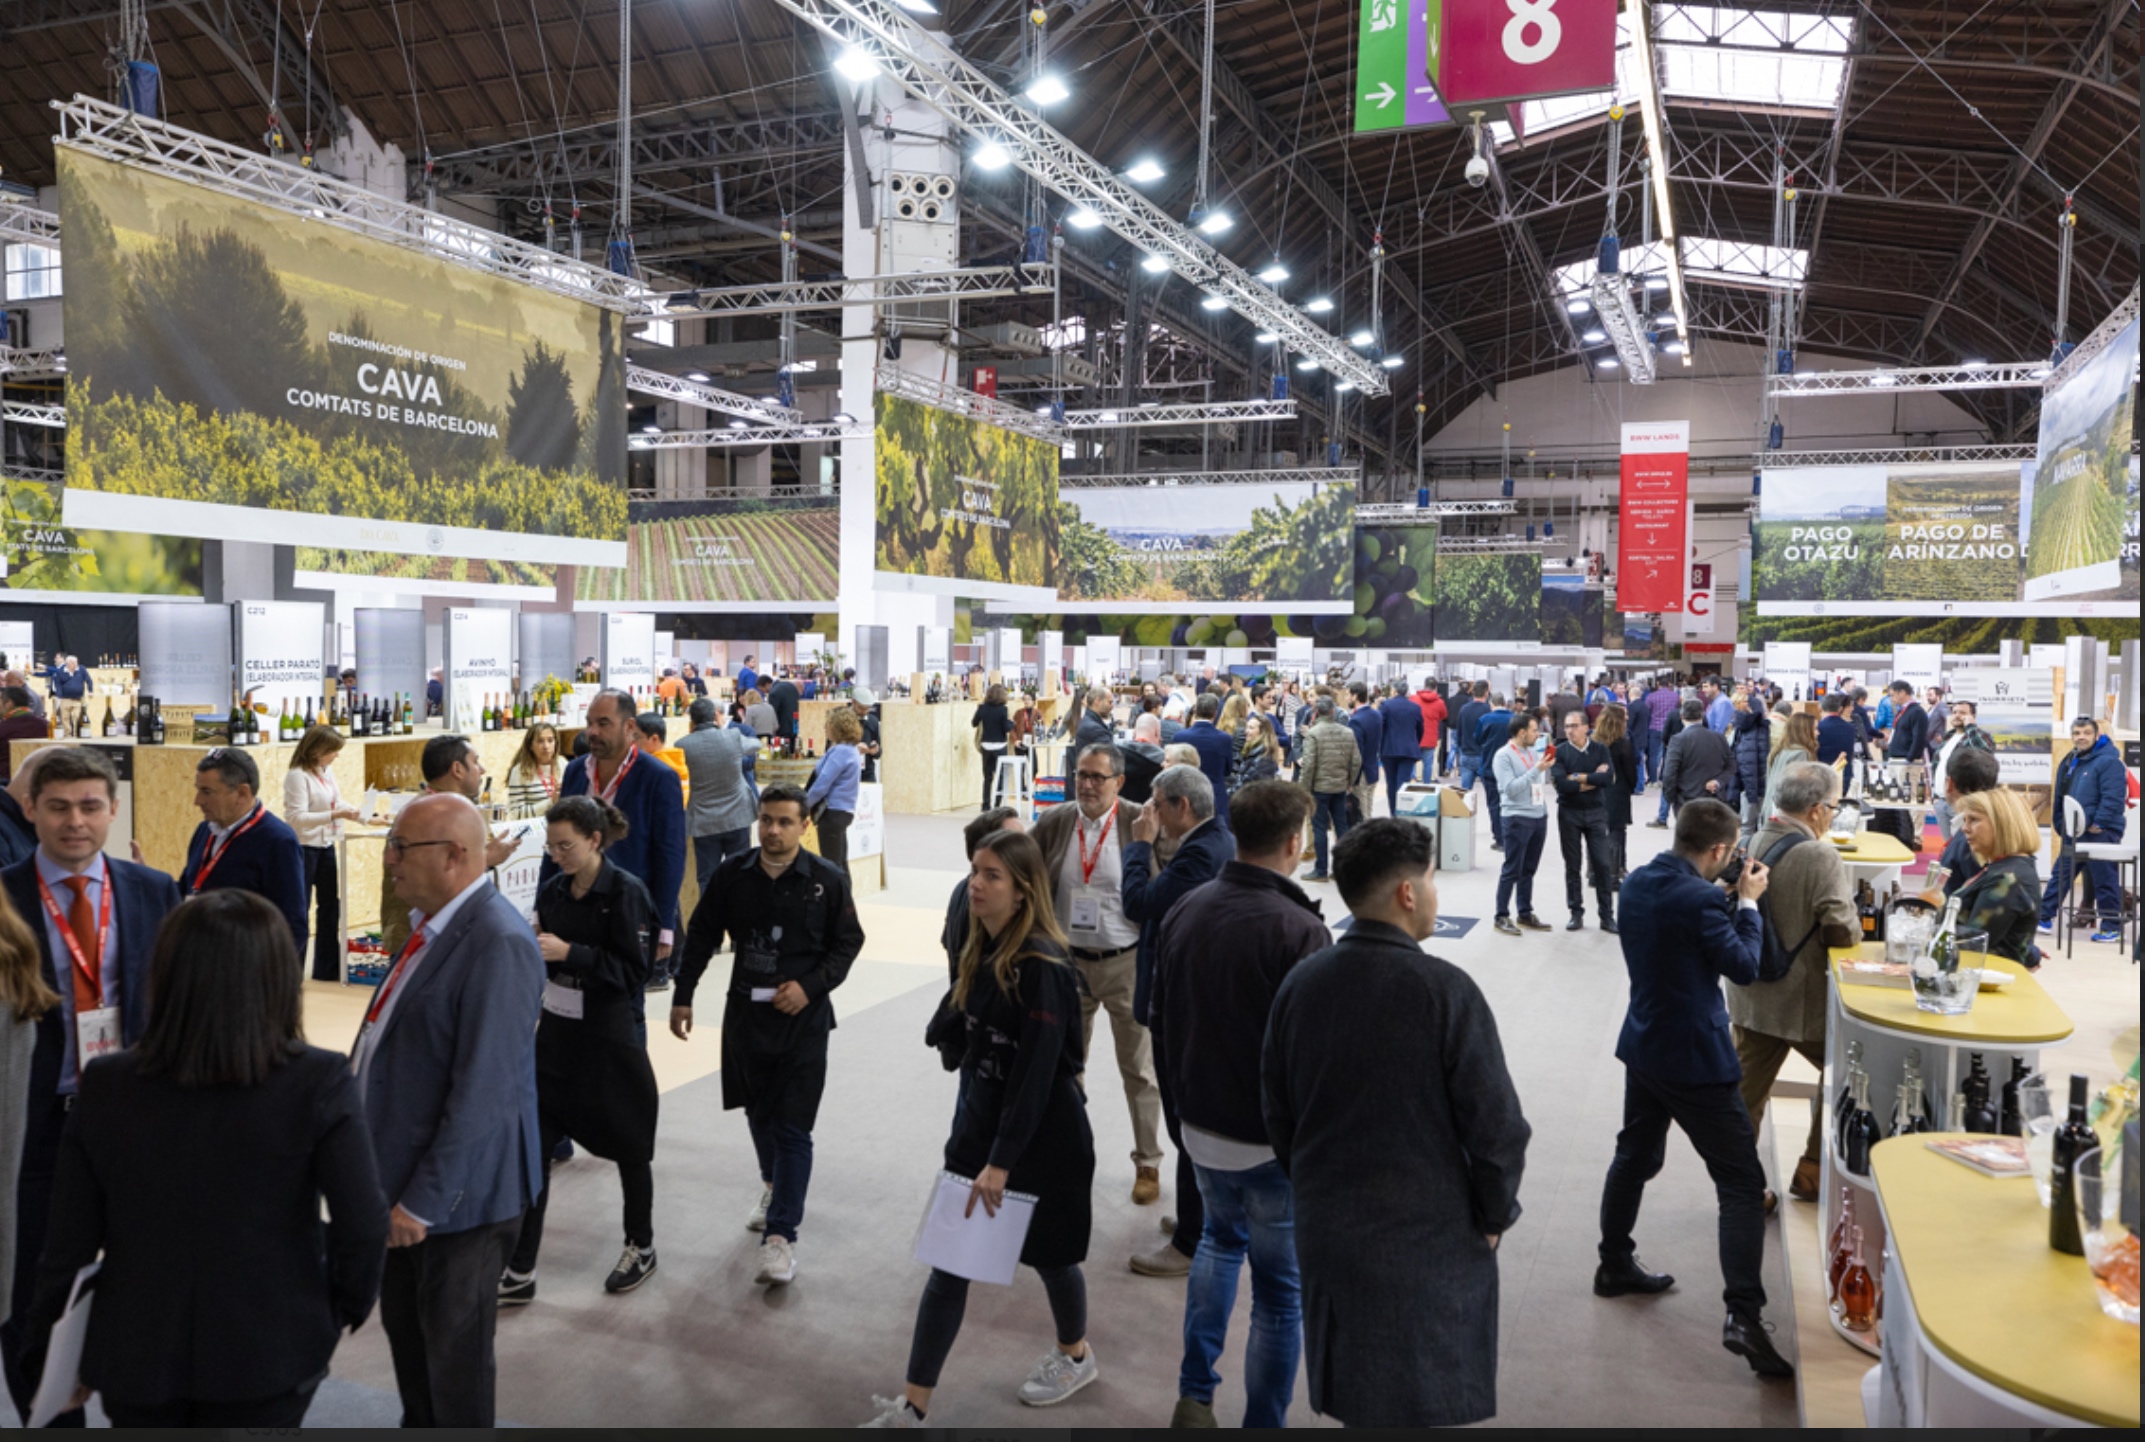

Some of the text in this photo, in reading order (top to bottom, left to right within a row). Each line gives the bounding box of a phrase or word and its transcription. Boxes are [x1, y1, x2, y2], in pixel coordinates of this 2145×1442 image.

[1501, 0, 1562, 64] 8
[328, 330, 467, 371] DENOMINACIÓN DE ORIGEN
[357, 362, 443, 406] CAVA
[286, 387, 499, 440] COMTATS DE BARCELONA
[963, 490, 992, 512] CAVA
[22, 529, 66, 544] CAVA
[1791, 526, 1853, 542] PAGO
[1900, 524, 2004, 541] PAGO DE
[695, 544, 730, 557] CAVA
[1140, 538, 1183, 552] CAVA
[1783, 545, 1859, 561] OTAZU
[1888, 541, 2015, 560] ARÍNZANO
[1693, 569, 1703, 585] 8
[1687, 592, 1709, 616] C
[245, 660, 286, 670] CELLER
